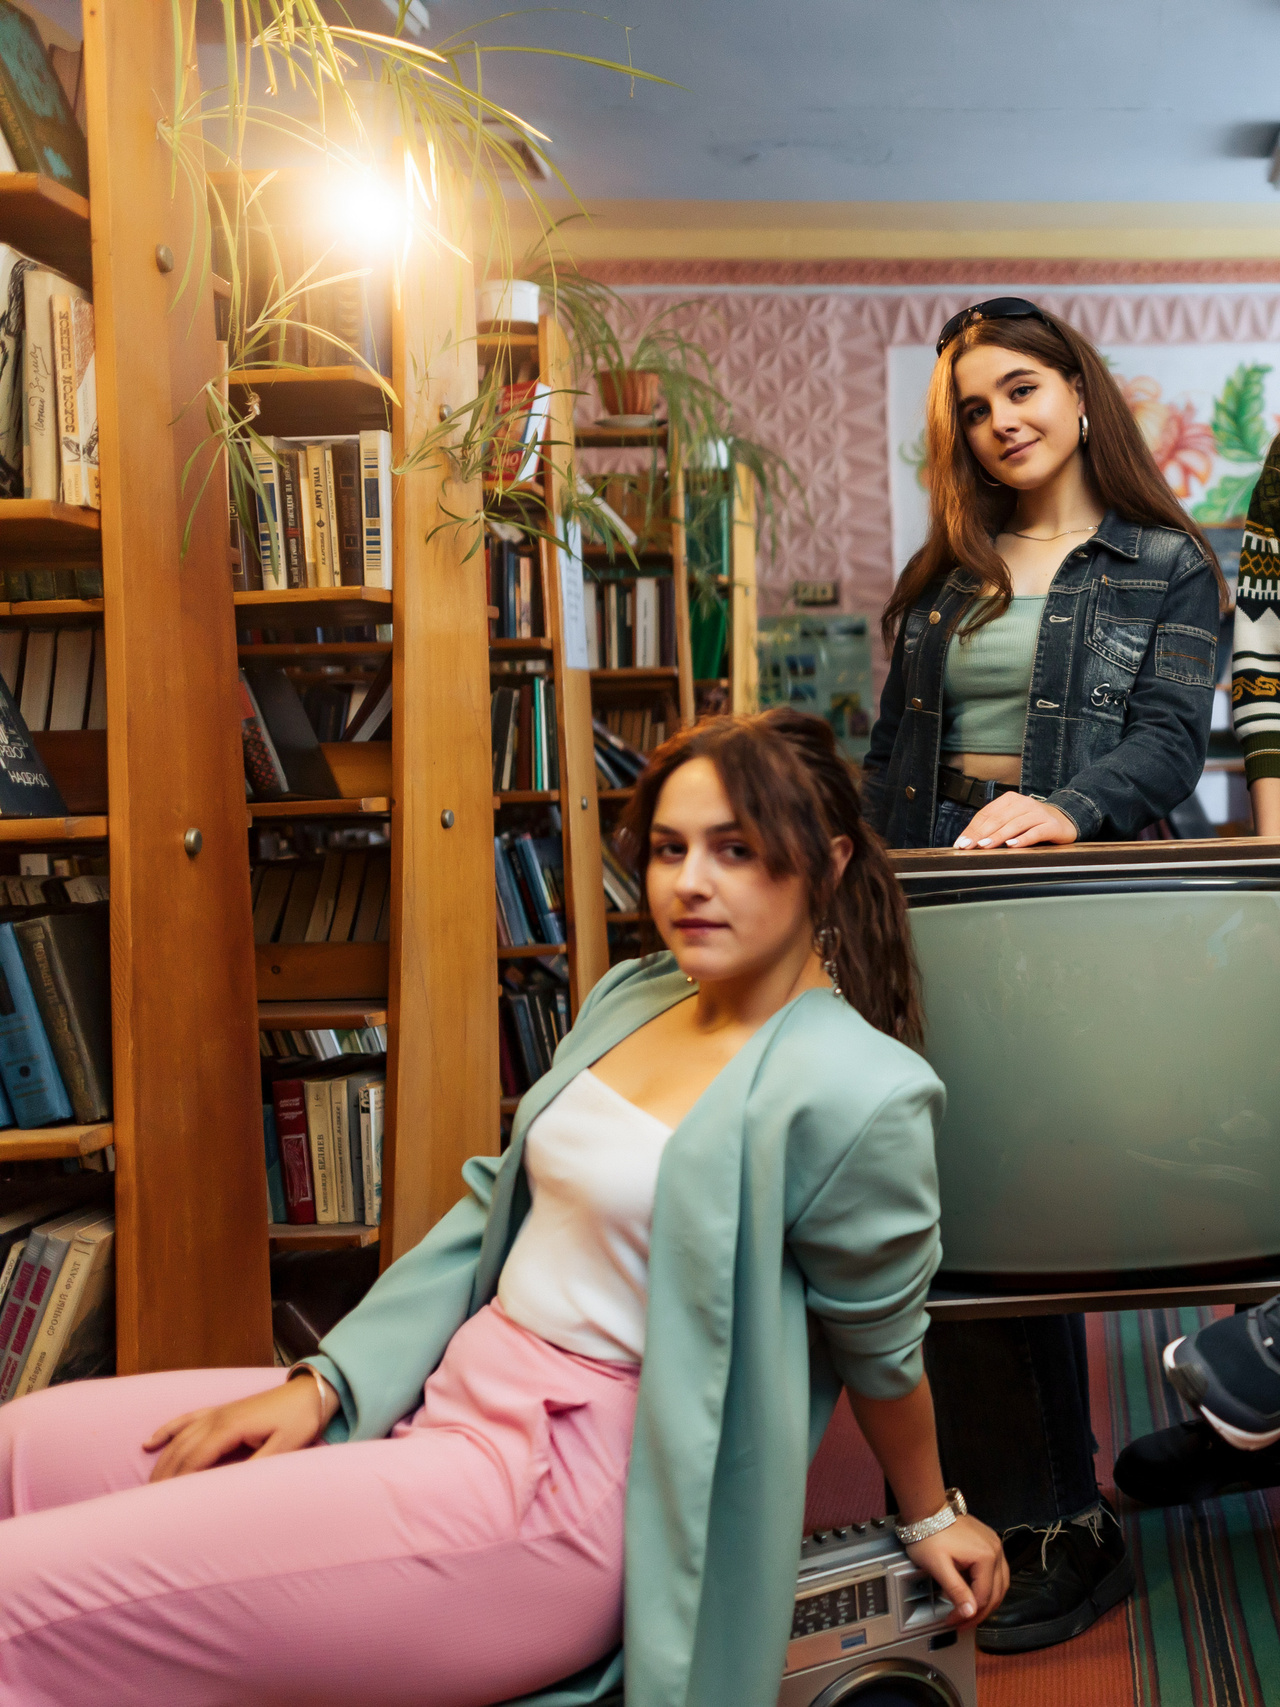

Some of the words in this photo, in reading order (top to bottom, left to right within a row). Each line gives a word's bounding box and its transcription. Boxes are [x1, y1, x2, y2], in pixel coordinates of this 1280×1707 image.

[59, 311, 71, 370] ТЕЛЕНОК
[61, 376, 75, 433] ЗОЛОТОЙ
[317, 1134, 326, 1171] БЕЛЯЕВ
[46, 1293, 69, 1337] СРОЧНЫЙ
[64, 1260, 82, 1290] ФРАХТ
